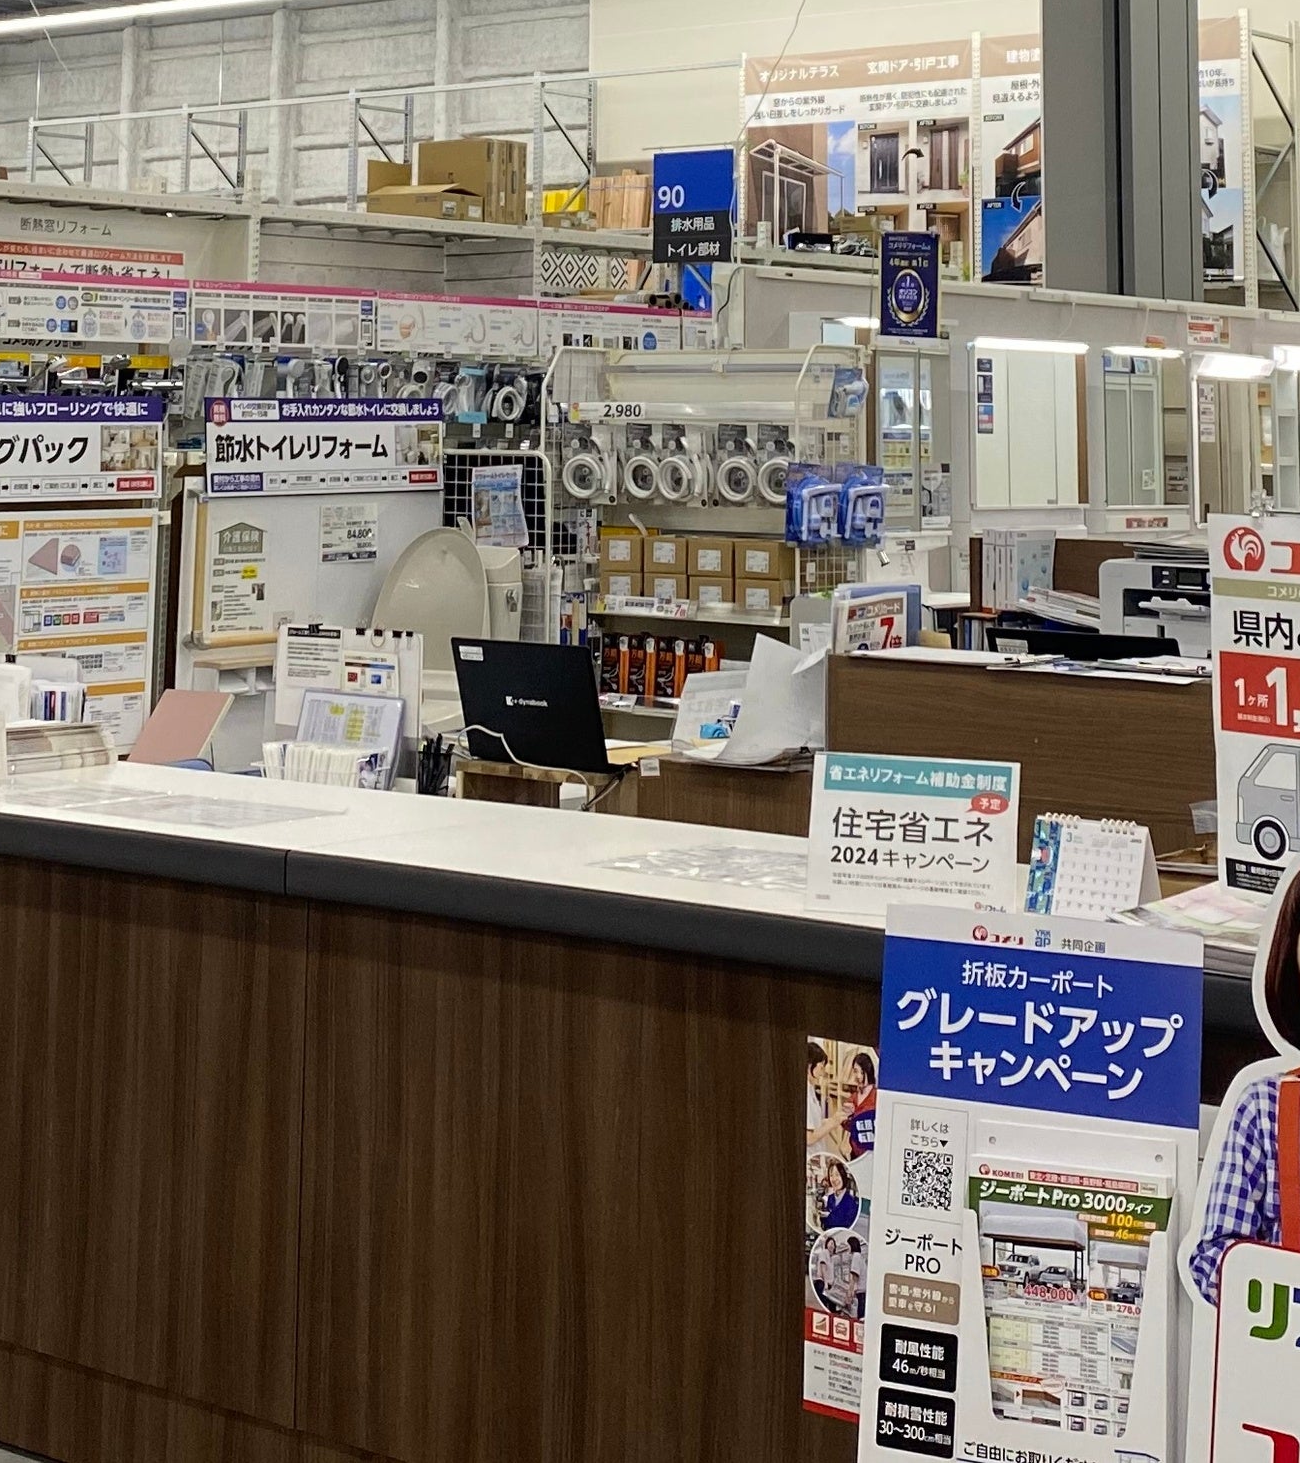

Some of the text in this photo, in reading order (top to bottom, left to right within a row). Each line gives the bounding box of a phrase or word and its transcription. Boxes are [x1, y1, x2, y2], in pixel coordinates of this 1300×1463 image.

[658, 184, 684, 208] 90
[670, 216, 715, 233] 排水用品
[666, 241, 721, 258] トイレ部材
[603, 404, 642, 419] 2,980
[215, 433, 389, 463] 節水トイレリフォーム
[829, 764, 1008, 793] 省エネリフォーム補助金制度
[979, 797, 1002, 811] 予定
[832, 806, 994, 847] 住宅省エネ
[830, 845, 990, 874] 2024 キャンペーン
[986, 933, 1025, 946] コメリ
[1061, 938, 1107, 954] 共同企画
[961, 959, 1114, 999] 折板カーポート
[896, 986, 1185, 1059] グレードアップ
[929, 1040, 1144, 1100] キャンペーン
[910, 1117, 949, 1134] 詳しくは
[910, 1134, 940, 1148] こちら
[992, 1169, 1025, 1180] KOMERI
[884, 1228, 964, 1256] ジーポート
[905, 1253, 941, 1275] PRO
[1023, 1285, 1074, 1302] 448,000
[894, 1338, 945, 1361] 耐風性能
[891, 1358, 946, 1380] 46m/秒相当
[884, 1400, 948, 1427] 耐積雪性能
